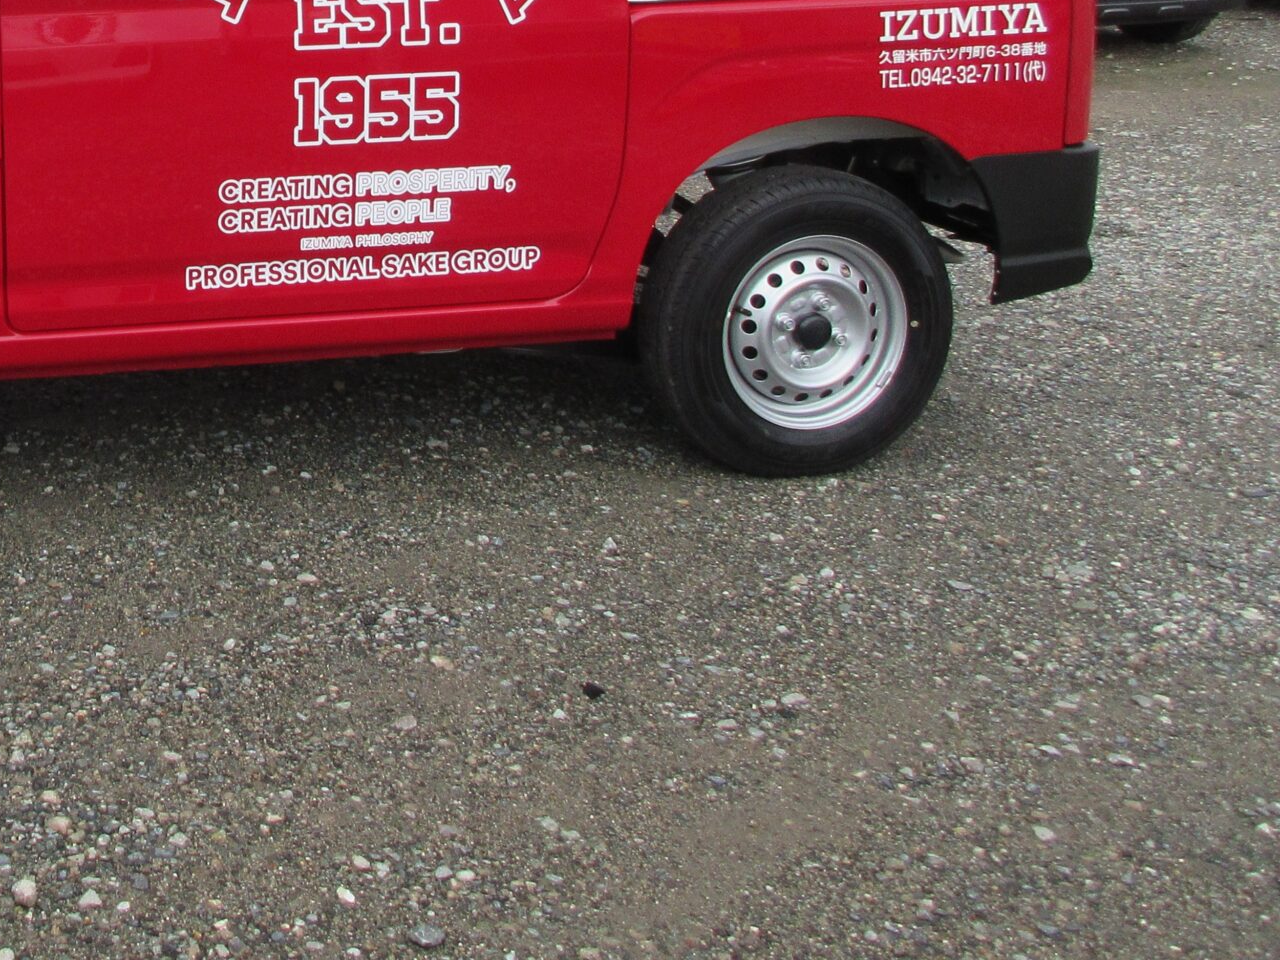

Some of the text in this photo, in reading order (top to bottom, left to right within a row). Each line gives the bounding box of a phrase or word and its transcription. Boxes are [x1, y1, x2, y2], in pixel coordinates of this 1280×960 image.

[879, 3, 1048, 43] IZUMIYA
[293, 71, 461, 147] 1955
[218, 165, 517, 205] CREATING PROSPERITY,
[218, 198, 451, 234] CREATING PEOPLE
[300, 231, 434, 251] IZUMIYA PHILOSOPHY
[185, 245, 541, 291] PROFESSIONAL SAKE GROUP
